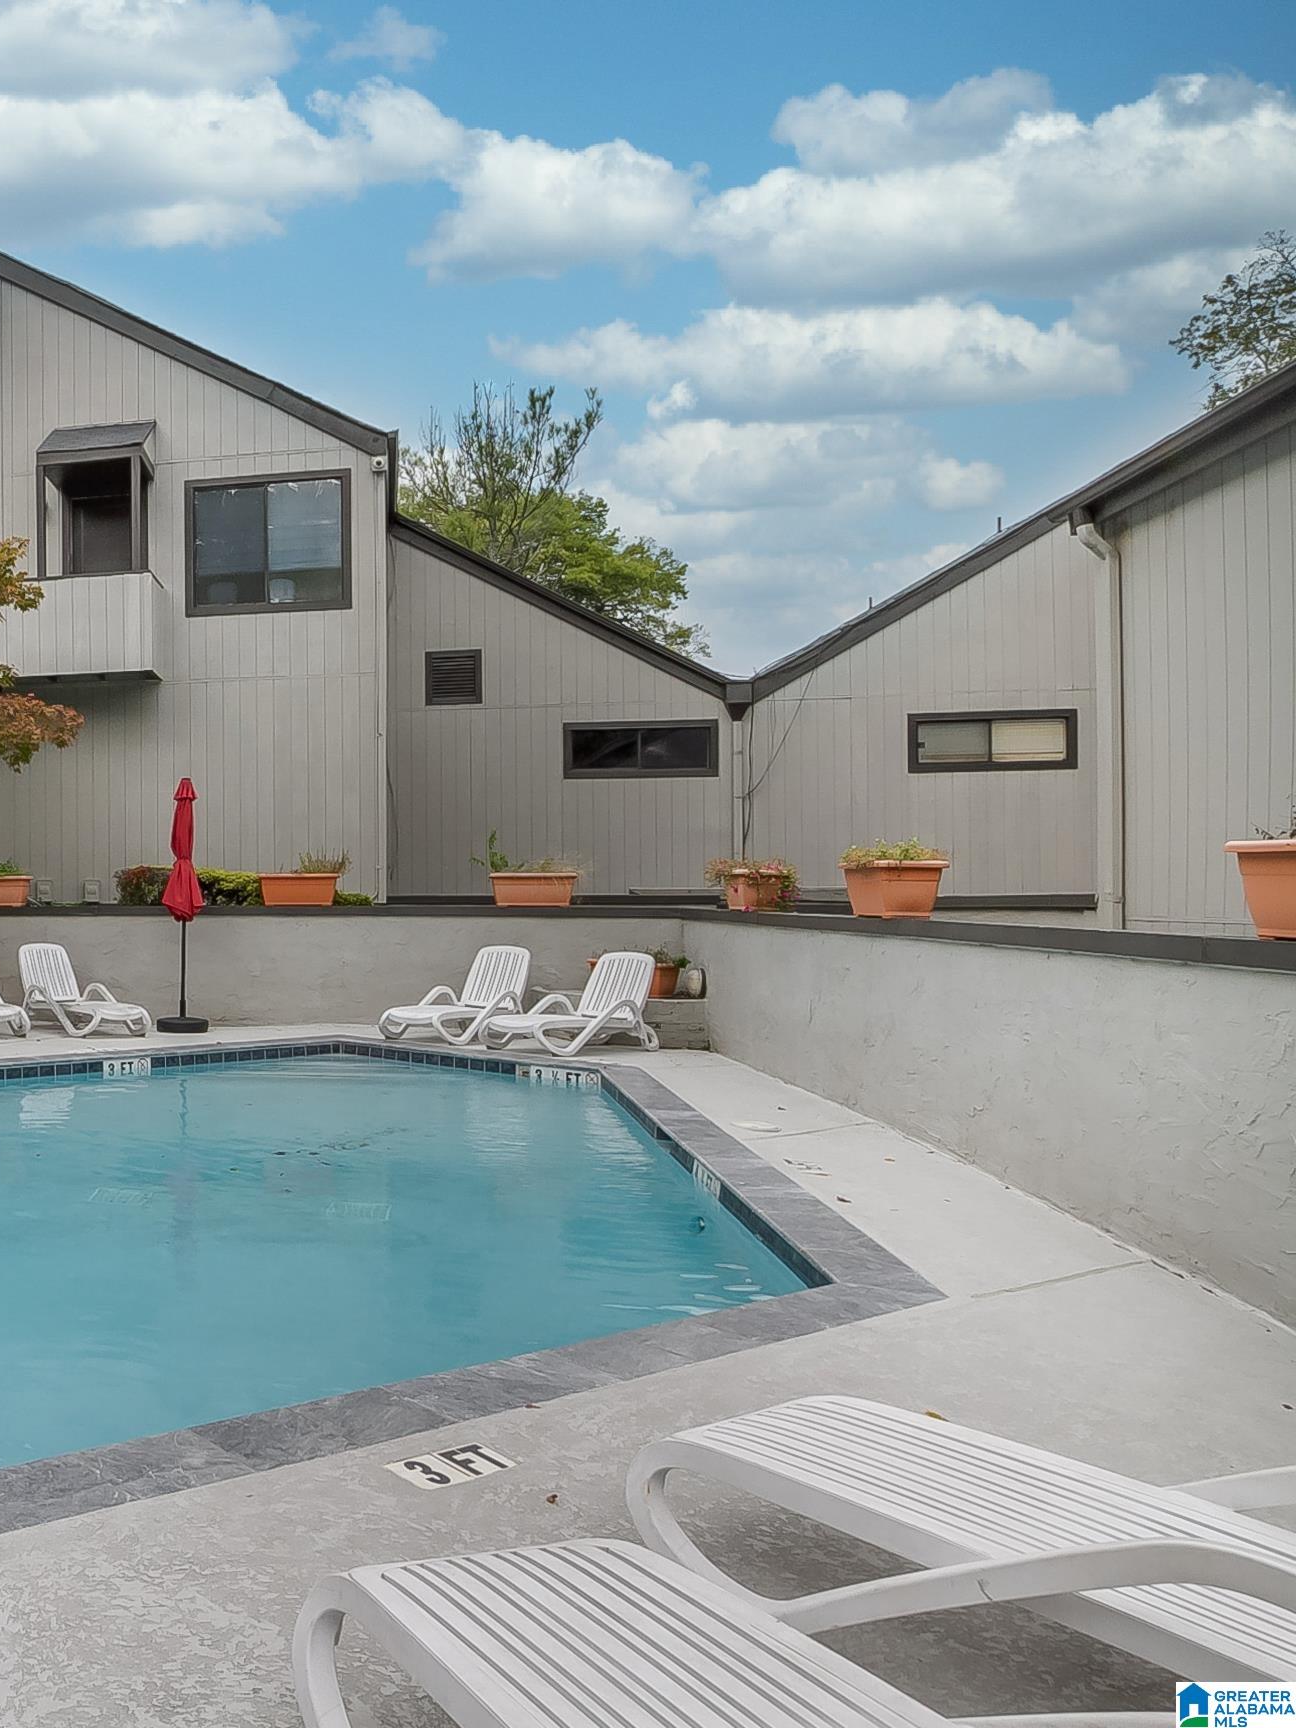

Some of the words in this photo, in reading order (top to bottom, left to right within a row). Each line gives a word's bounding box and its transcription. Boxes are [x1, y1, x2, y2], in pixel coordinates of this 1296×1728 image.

[108, 1062, 115, 1077] 3
[121, 1061, 134, 1076] FT
[404, 1460, 451, 1485] 3
[437, 1443, 509, 1476] FT
